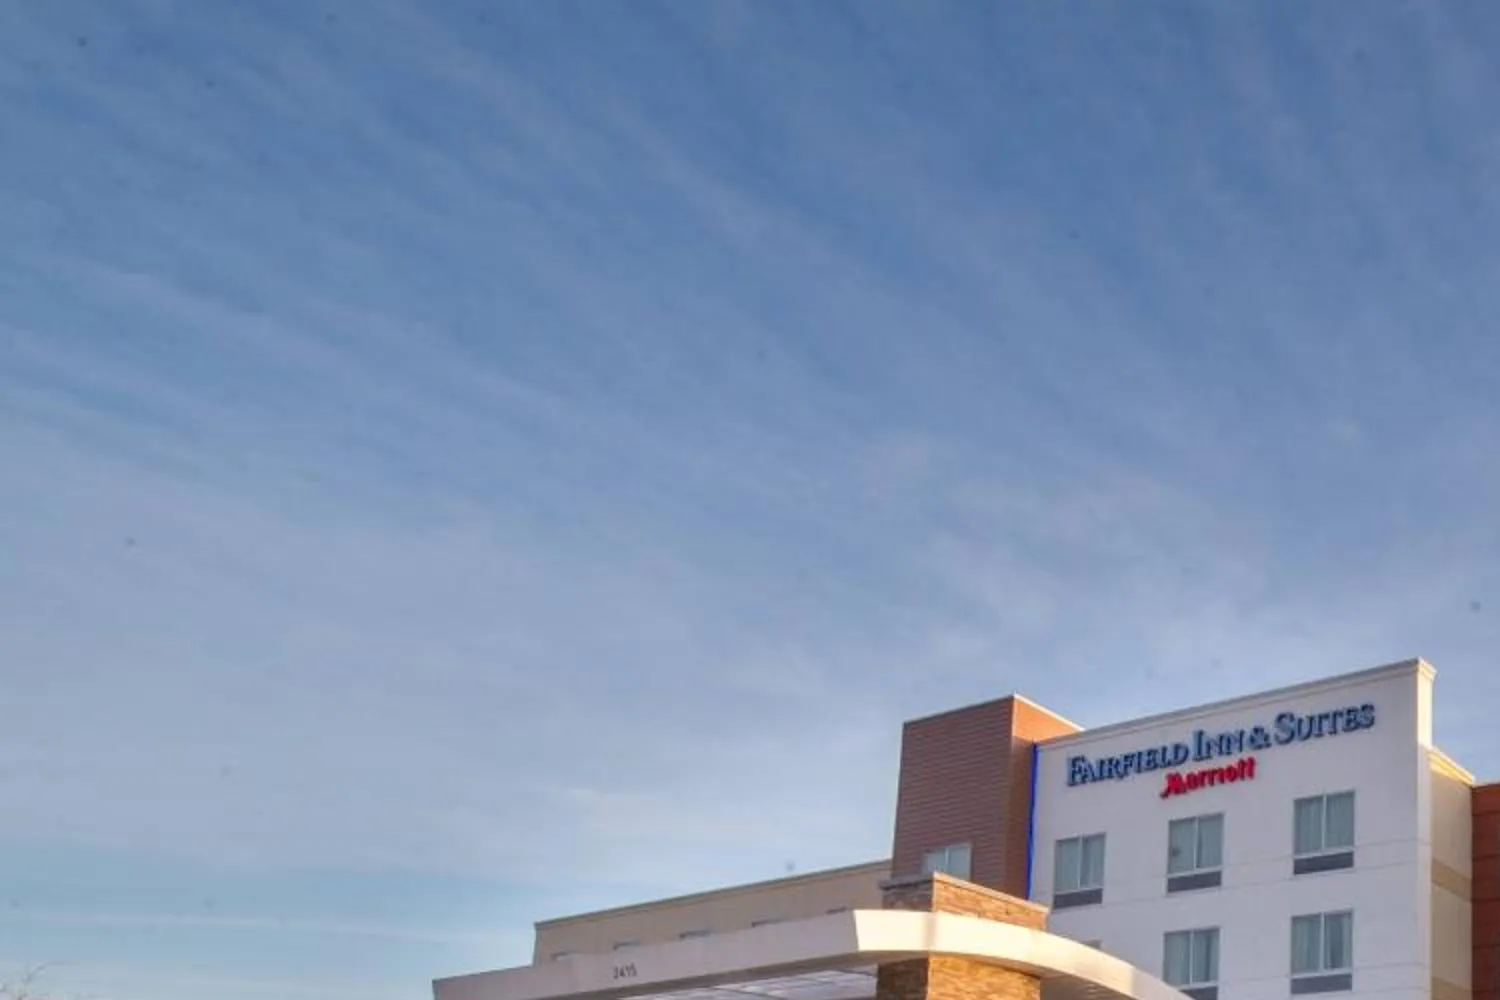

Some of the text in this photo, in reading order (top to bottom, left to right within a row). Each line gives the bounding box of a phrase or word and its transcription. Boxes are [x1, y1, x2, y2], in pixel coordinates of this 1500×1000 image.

[1067, 703, 1376, 787] FAIRFIELD INN & SUITES
[1159, 756, 1256, 799] Marriott
